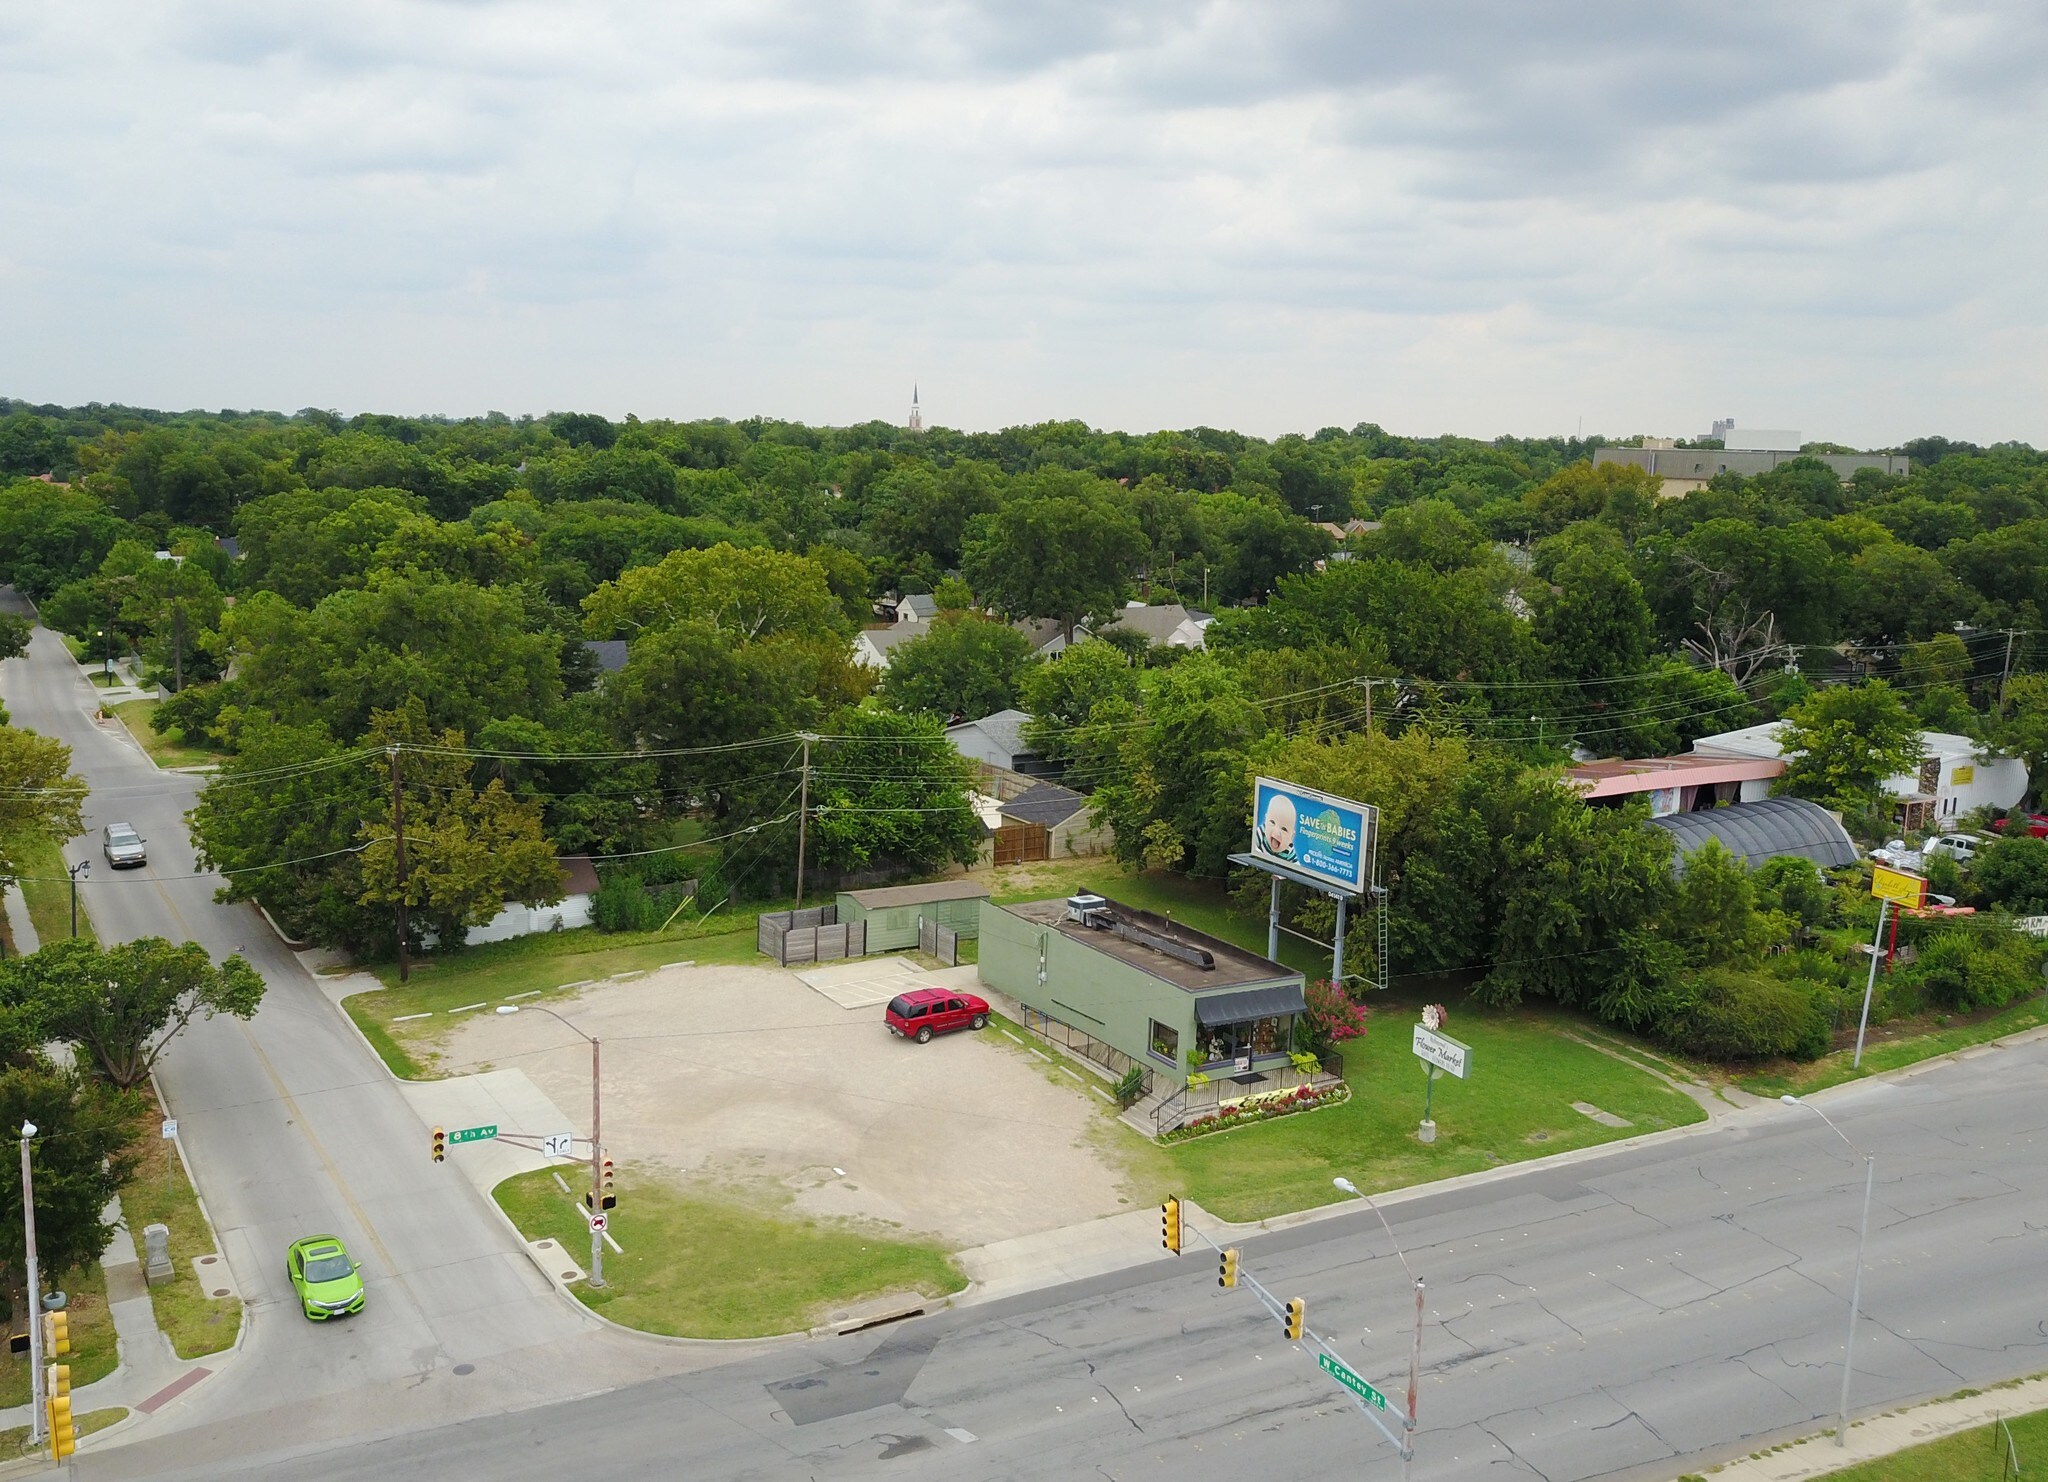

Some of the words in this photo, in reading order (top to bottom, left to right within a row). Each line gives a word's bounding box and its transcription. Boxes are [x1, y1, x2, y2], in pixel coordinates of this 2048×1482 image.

[1299, 814, 1320, 829] SAVE
[1326, 823, 1356, 842] BABIES
[1299, 827, 1332, 843] Fingerprints
[1336, 840, 1354, 851] weeks
[1415, 1036, 1436, 1054] Flower
[1438, 1046, 1462, 1068] Market
[480, 1128, 494, 1136] Av
[1323, 1357, 1331, 1369] W
[1334, 1365, 1367, 1395] Cantey
[1371, 1391, 1381, 1405] St
